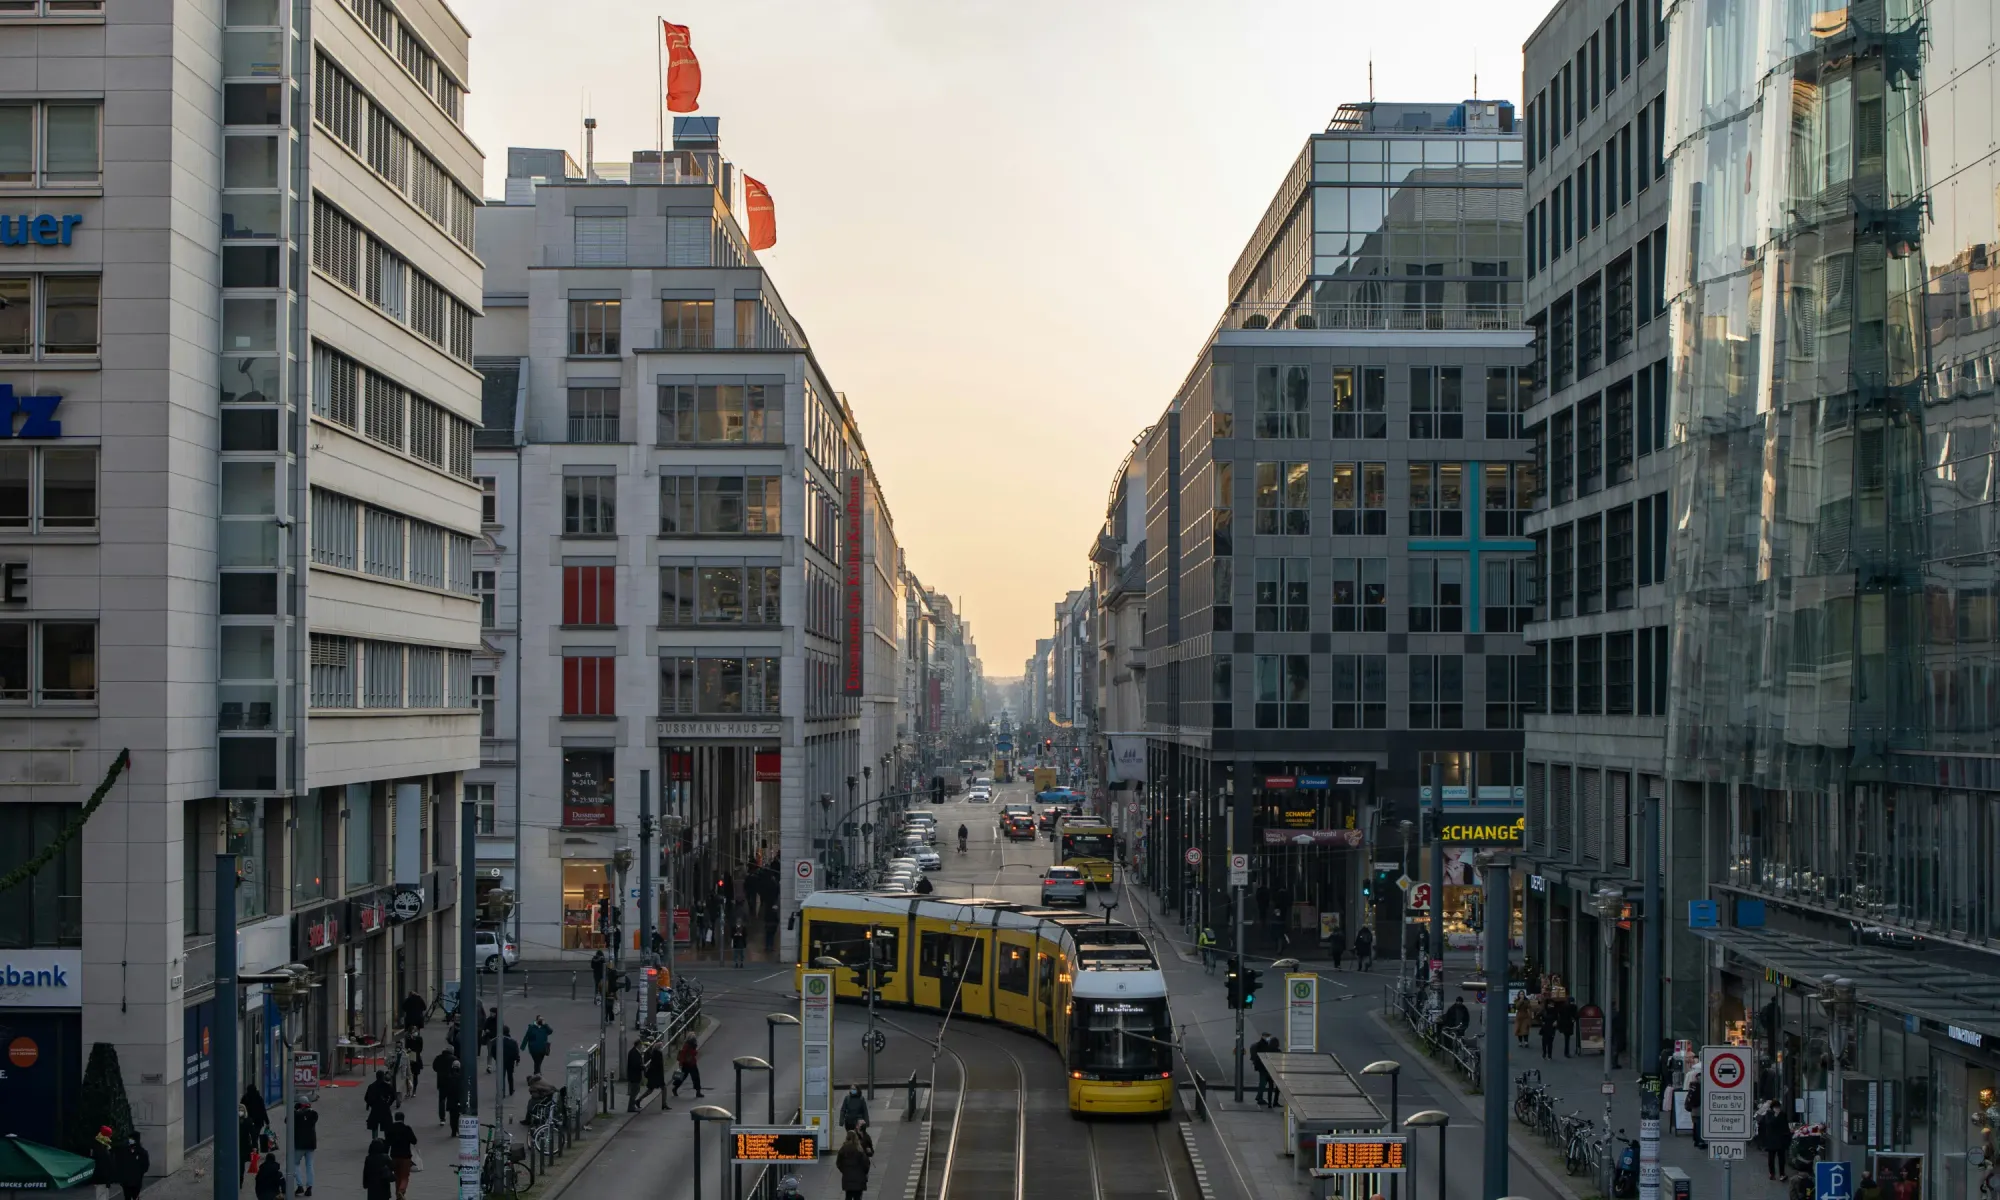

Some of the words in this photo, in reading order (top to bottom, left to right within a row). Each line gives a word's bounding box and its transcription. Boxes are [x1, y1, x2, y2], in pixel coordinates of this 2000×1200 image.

[846, 617, 861, 690] Dussmann
[657, 723, 758, 734] DUSSMANN-HAUS
[572, 811, 606, 819] Dussmann
[1442, 825, 1519, 840] EXCHANGE
[1095, 1004, 1104, 1012] M1
[1711, 1093, 1732, 1101] Diesel
[1733, 1093, 1743, 1101] bis
[1713, 1116, 1741, 1125] Anlieger
[1712, 1145, 1729, 1155] 100
[1731, 1147, 1742, 1155] m
[1831, 1173, 1844, 1195] P
